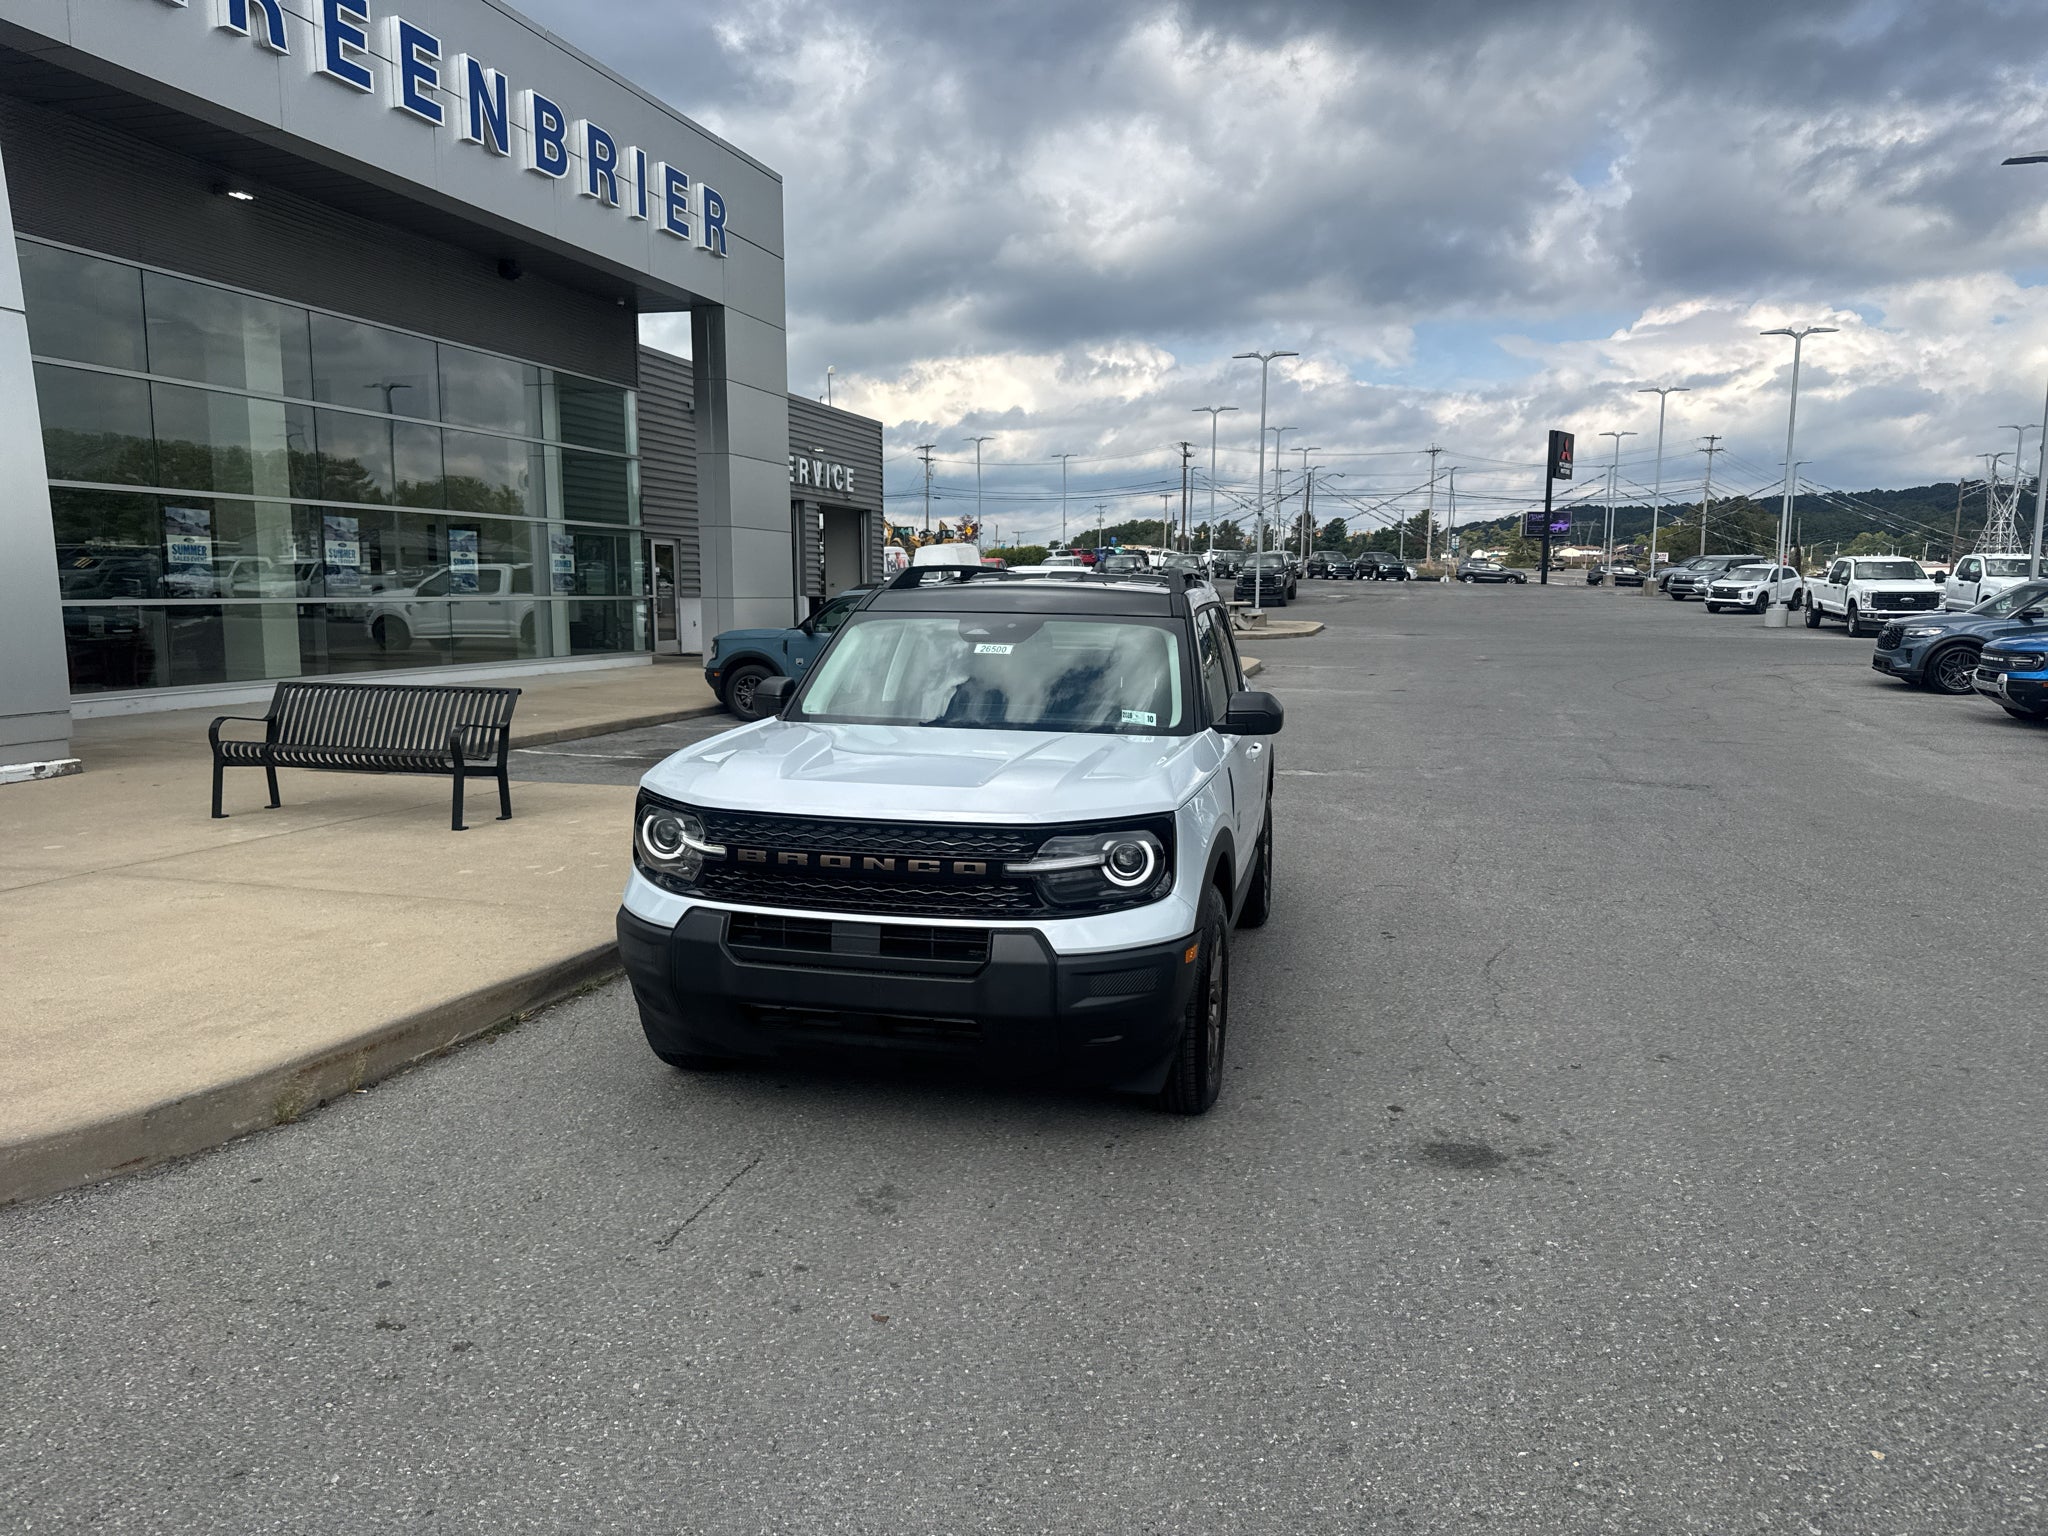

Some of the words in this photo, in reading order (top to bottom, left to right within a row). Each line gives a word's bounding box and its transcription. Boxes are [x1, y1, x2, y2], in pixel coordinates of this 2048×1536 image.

[165, 0, 729, 258] EENBRIER
[171, 544, 207, 557] SUMMER
[328, 548, 356, 559] SUMMER
[980, 645, 1007, 654] 26500
[1147, 714, 1154, 723] 10
[737, 849, 987, 875] BRONCO
